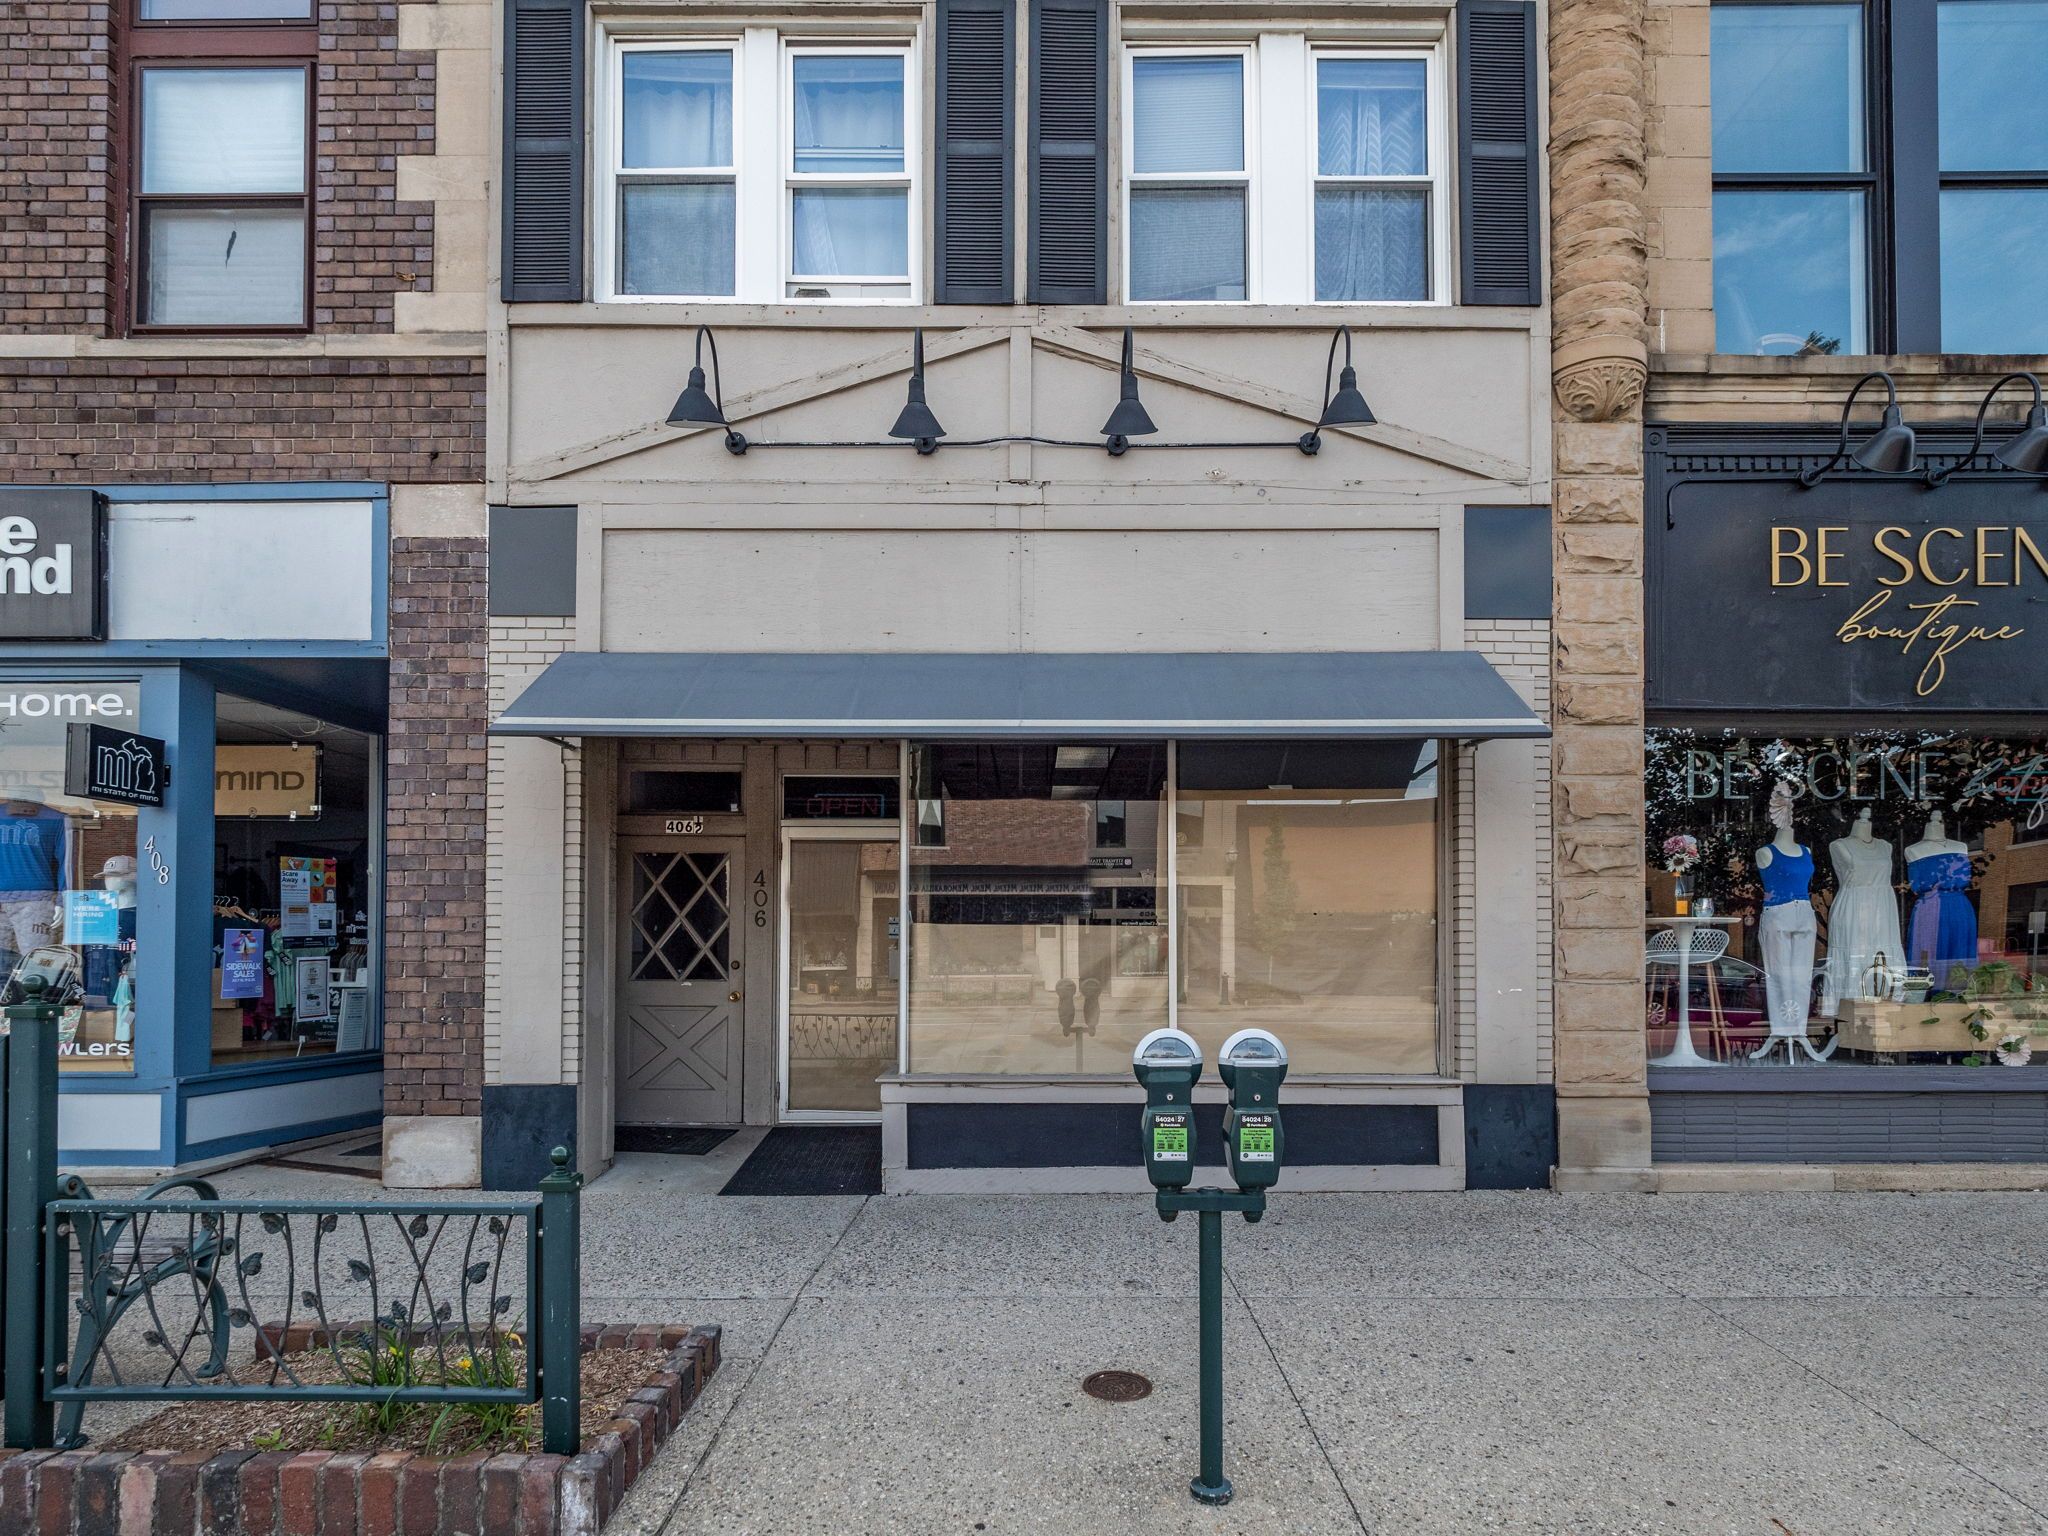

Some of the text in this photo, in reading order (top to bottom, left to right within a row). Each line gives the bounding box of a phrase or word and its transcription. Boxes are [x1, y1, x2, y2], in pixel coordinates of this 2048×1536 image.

[1771, 526, 2048, 587] BE SCEN
[1836, 589, 2025, 697] boutique
[1687, 750, 1945, 801] BE SCENE
[807, 798, 878, 815] OPEN
[144, 834, 169, 885] 408
[281, 876, 299, 884] Away
[753, 869, 768, 928] 406
[226, 962, 261, 971] SIDEWALK
[233, 970, 255, 978] SALES
